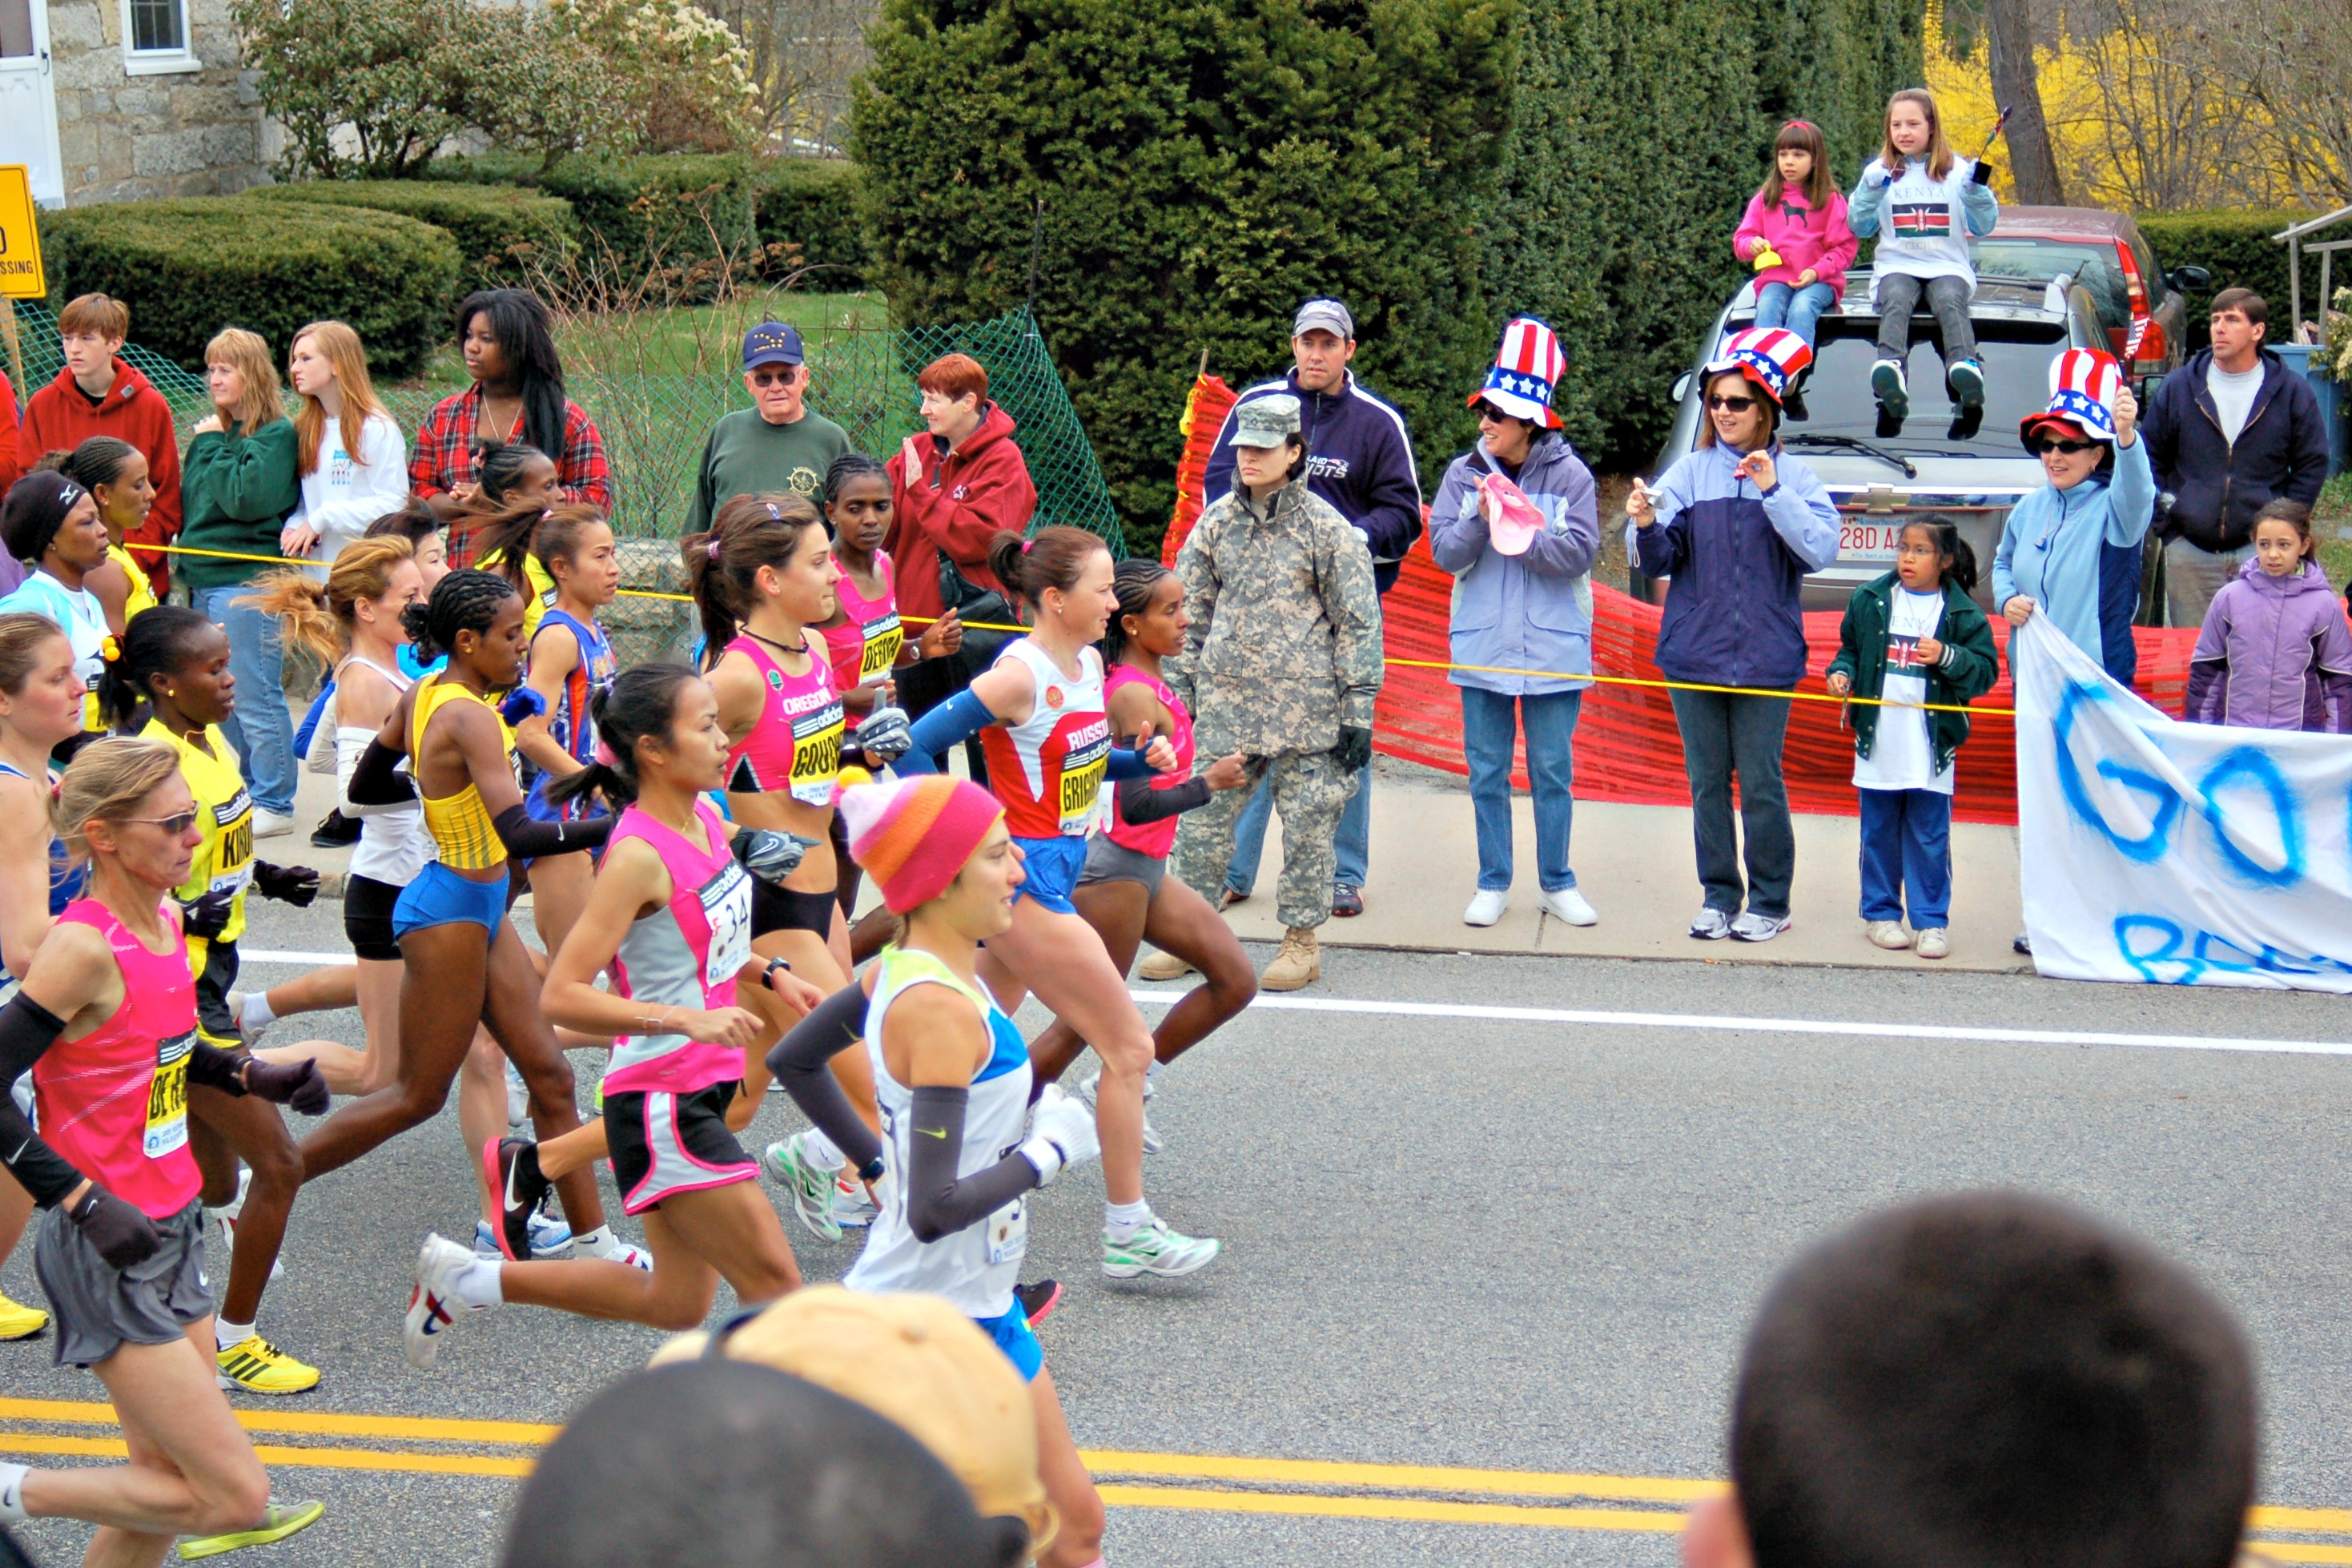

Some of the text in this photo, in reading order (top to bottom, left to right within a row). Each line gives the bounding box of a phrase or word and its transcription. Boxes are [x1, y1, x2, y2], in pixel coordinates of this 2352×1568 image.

[1894, 187, 1945, 199] KENYA
[0, 260, 34, 275] SSING
[1308, 463, 1347, 478] IOTS
[1839, 526, 1878, 549] 28D
[782, 686, 832, 715] OREGON
[817, 706, 844, 728] adidas
[726, 891, 749, 943] 34
